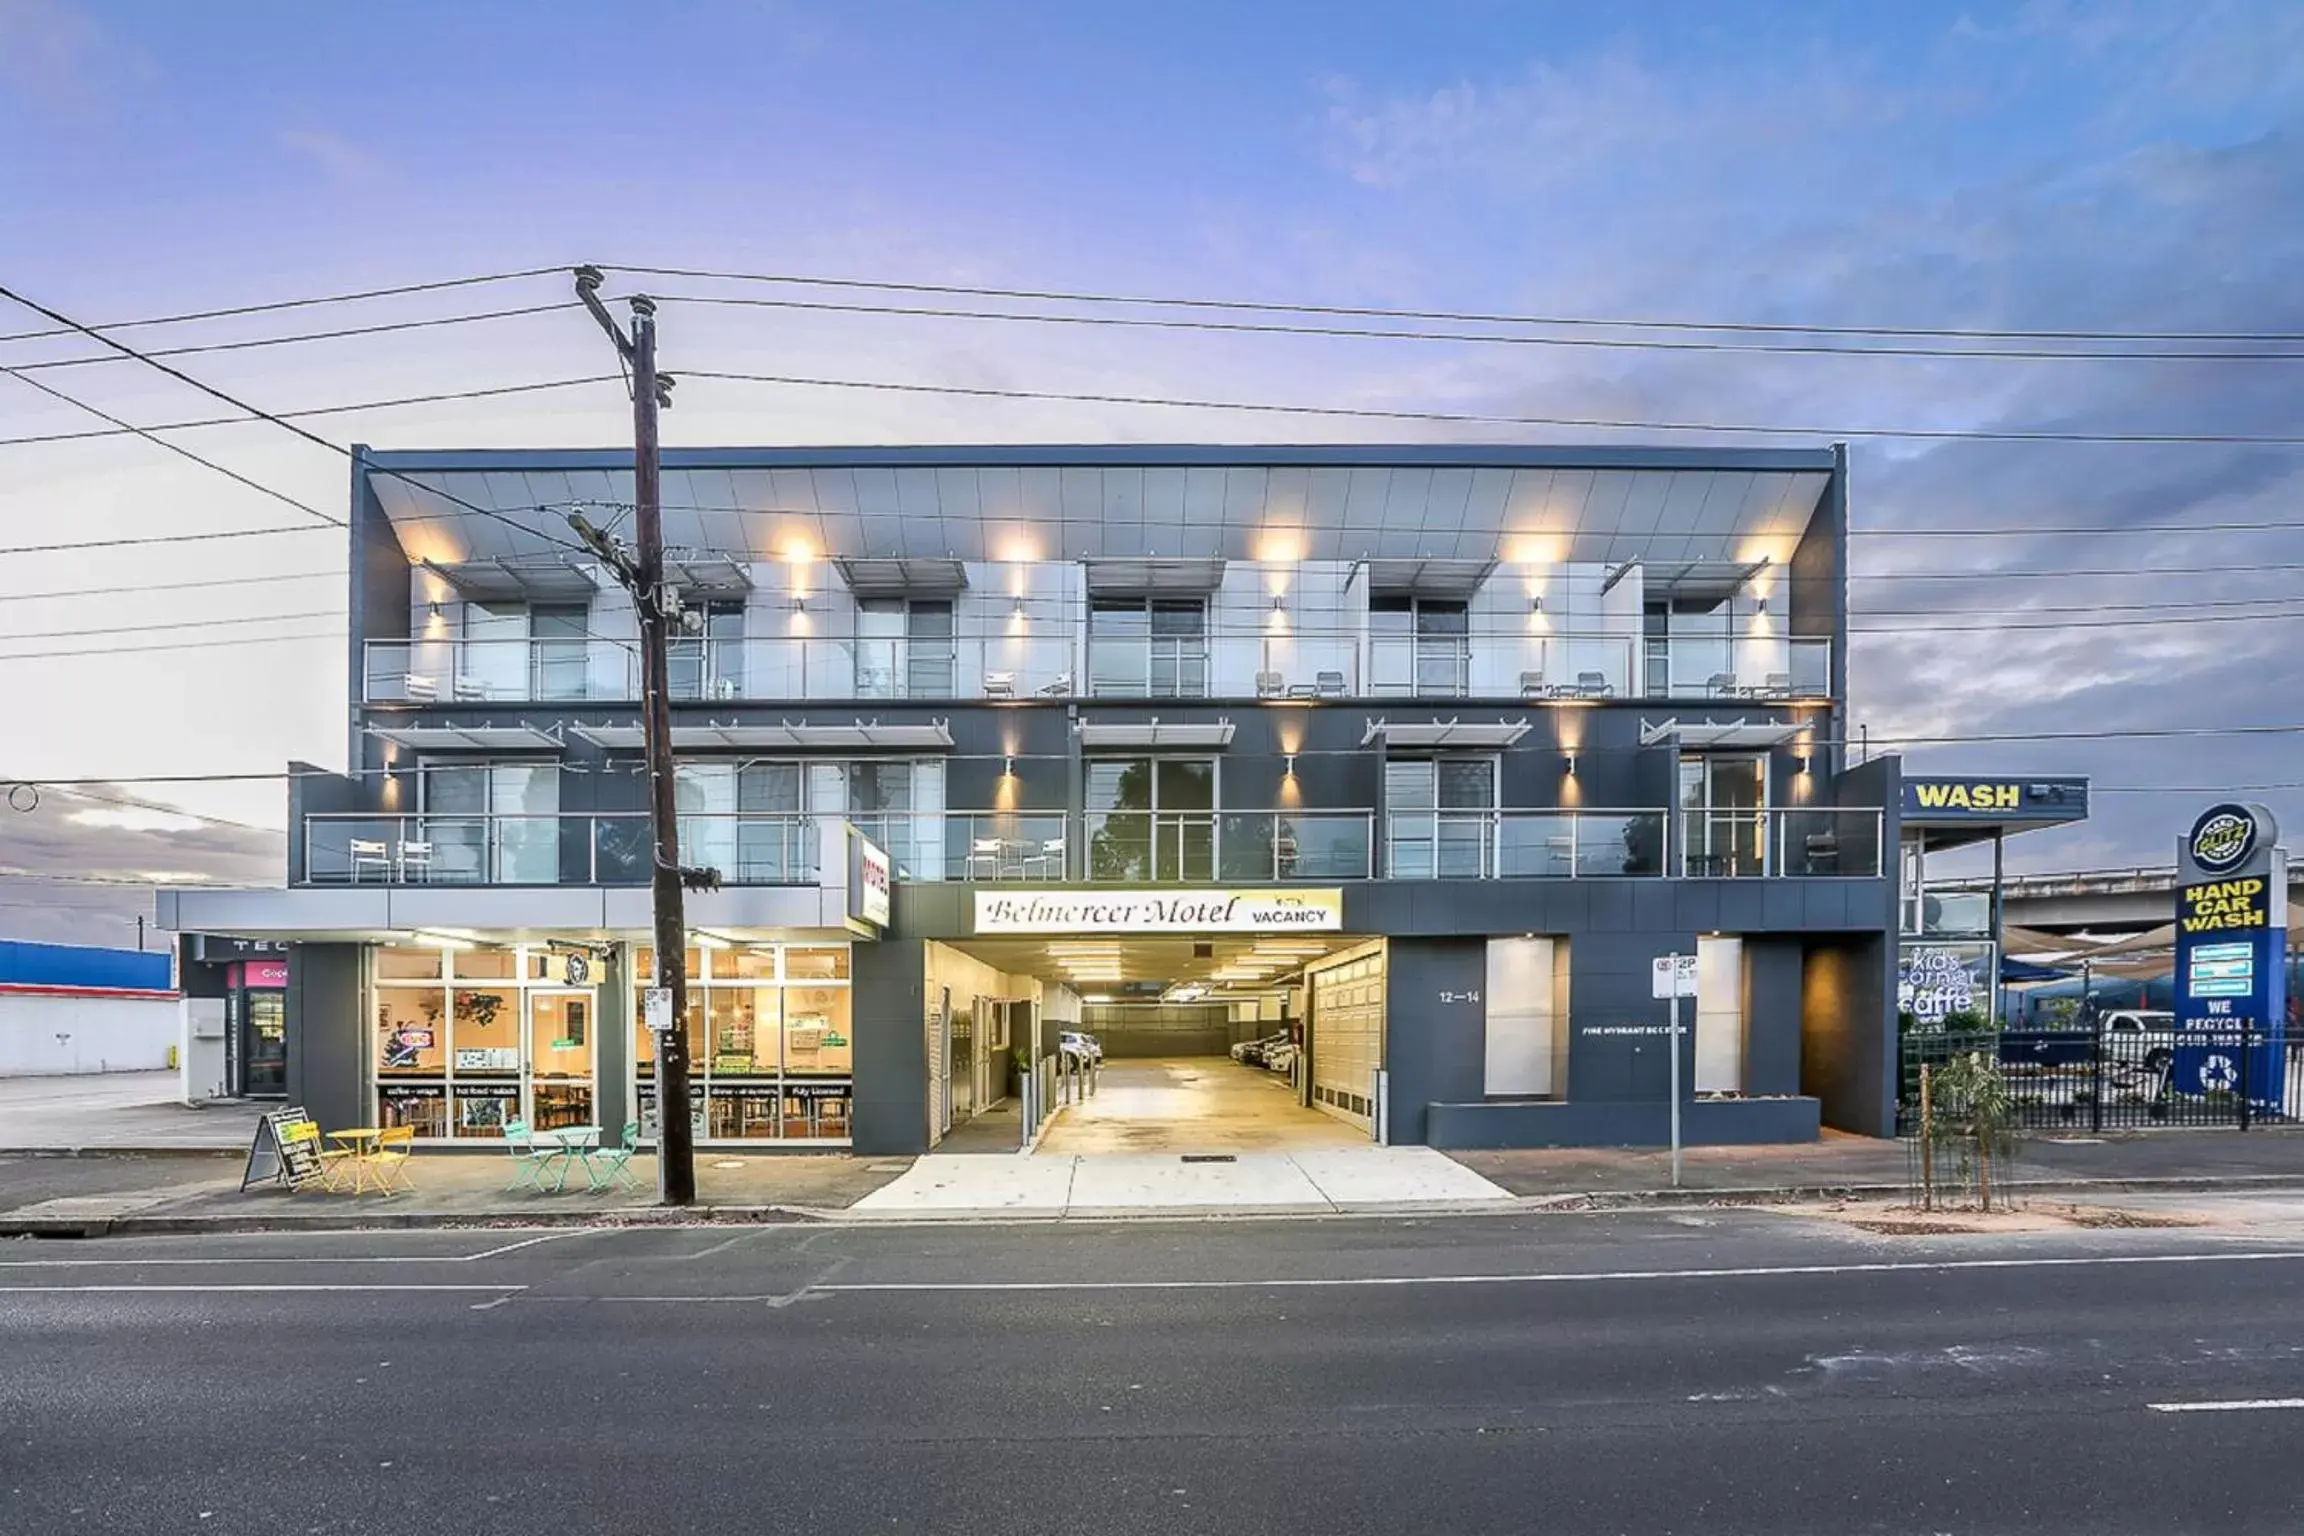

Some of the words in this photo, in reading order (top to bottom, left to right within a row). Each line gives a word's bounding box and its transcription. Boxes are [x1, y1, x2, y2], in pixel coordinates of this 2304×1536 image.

[1915, 784, 2019, 808] WASH
[2185, 879, 2263, 902] HAND
[986, 896, 1138, 924] Belmercer
[1144, 895, 1241, 923] Motel
[1252, 909, 1327, 923] VACANCY
[2195, 896, 2250, 917] CAR
[2182, 909, 2264, 932] WASH
[2207, 1000, 2232, 1014] WE
